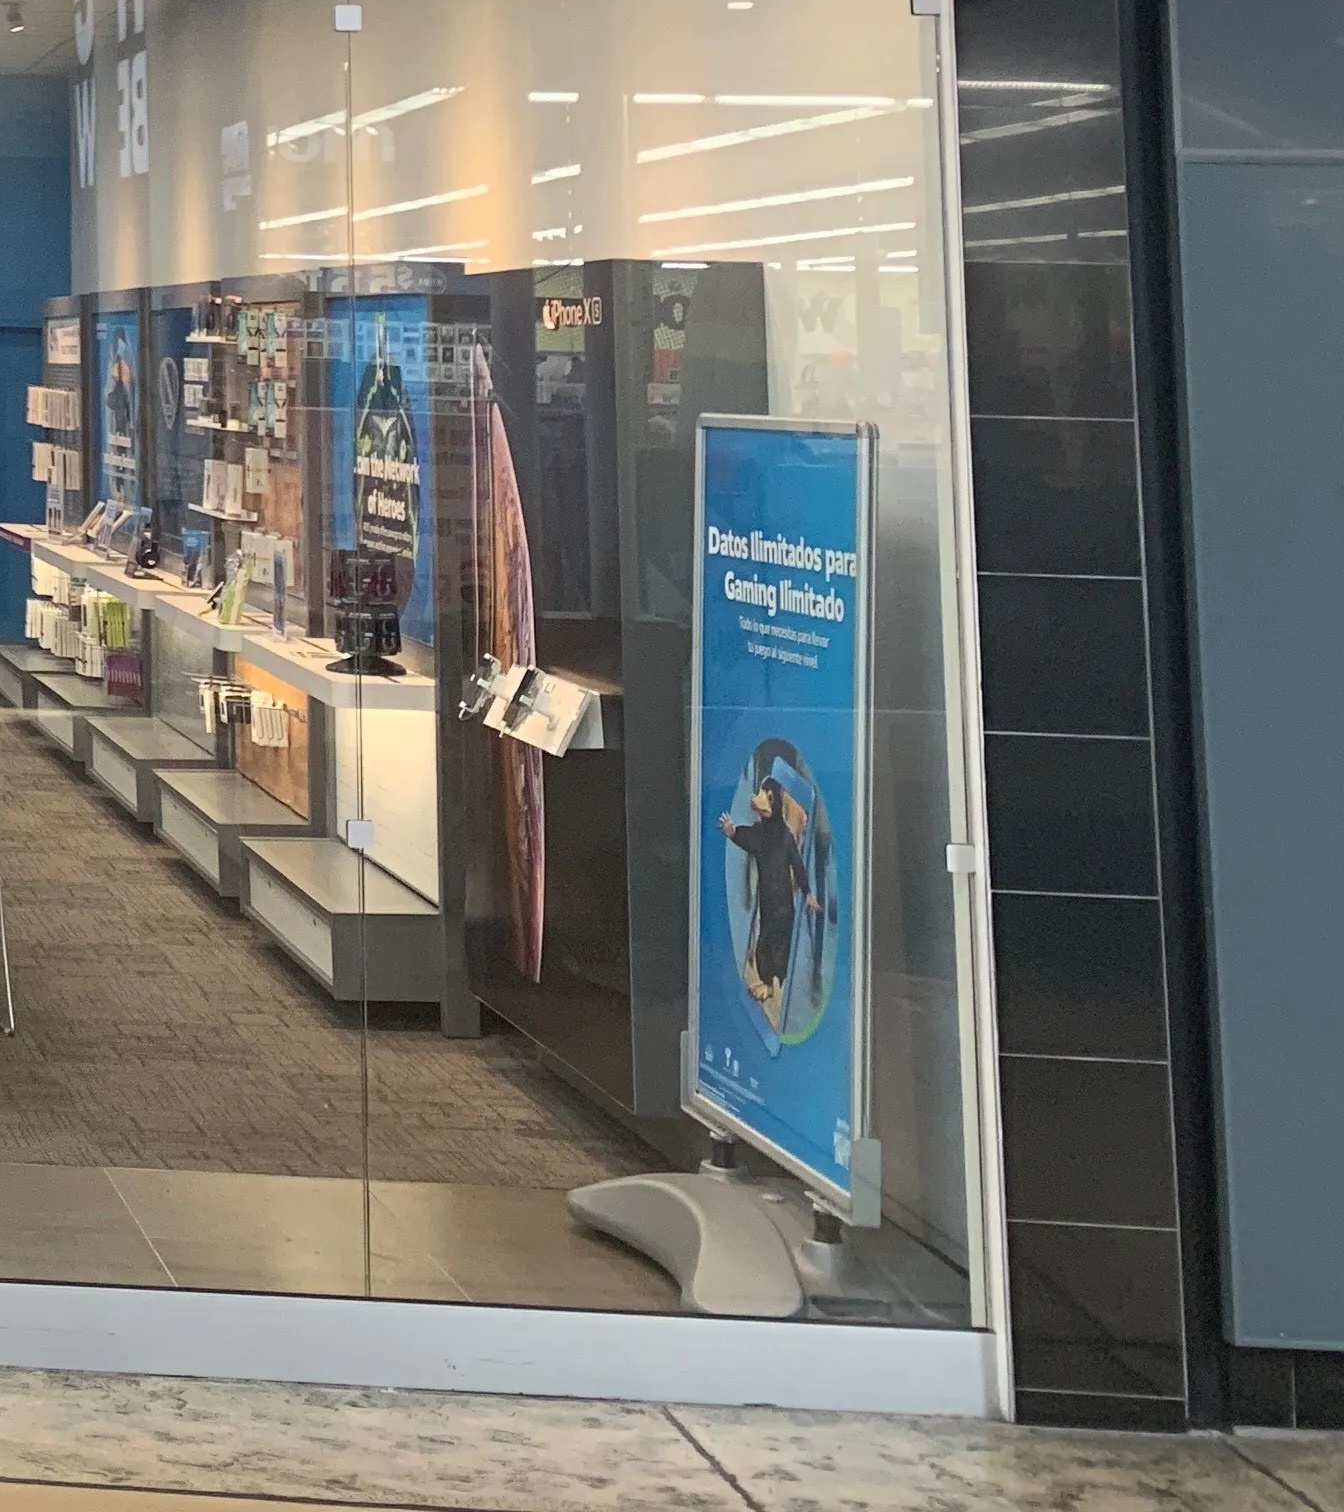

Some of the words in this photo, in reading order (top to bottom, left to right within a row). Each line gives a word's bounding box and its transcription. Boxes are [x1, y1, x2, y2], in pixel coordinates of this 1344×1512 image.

[549, 299, 583, 326] iPhone
[370, 451, 385, 478] the
[384, 455, 421, 485] Network
[367, 488, 378, 515] of
[377, 491, 407, 522] Heroes
[708, 525, 749, 560] Datos
[750, 530, 822, 572] Ilimitados
[825, 548, 858, 583] para
[724, 570, 778, 617] Gaming
[779, 579, 845, 622] Ilimitado
